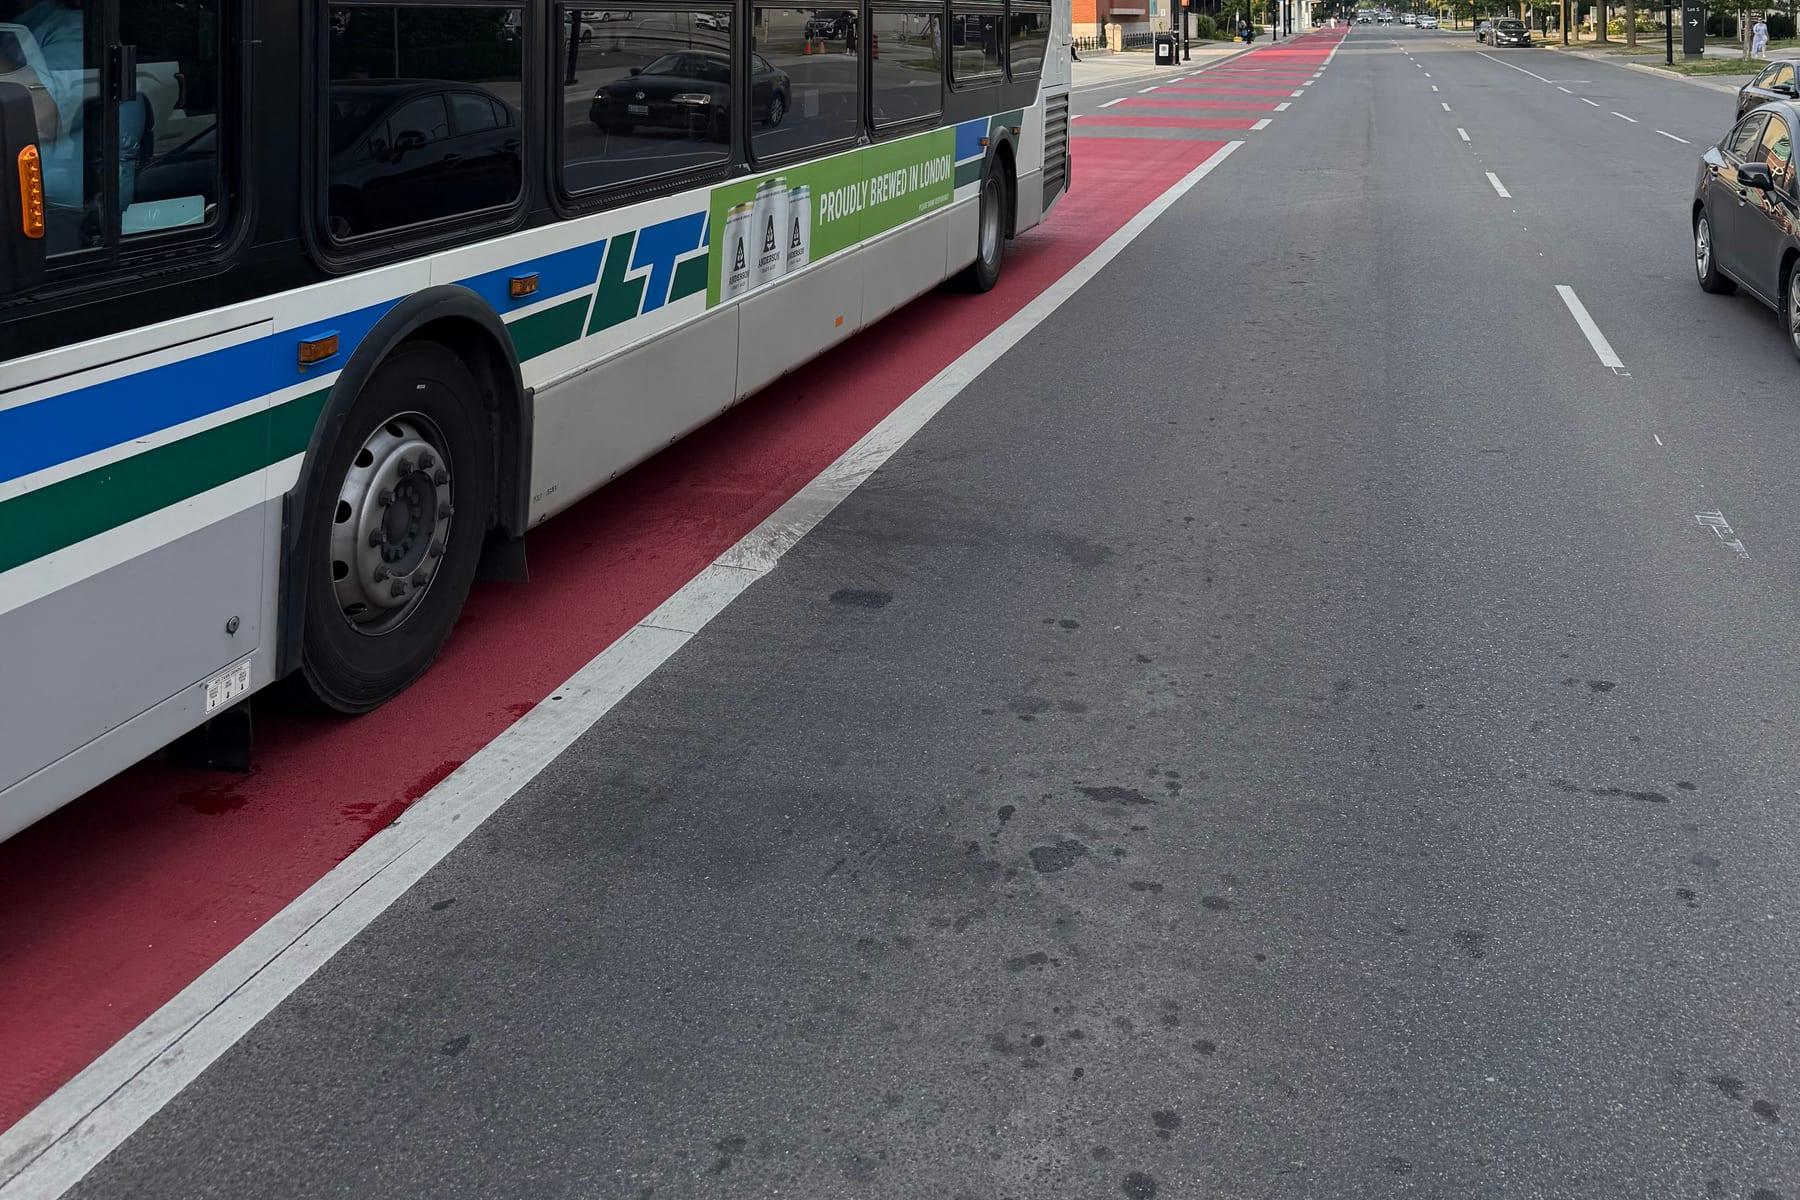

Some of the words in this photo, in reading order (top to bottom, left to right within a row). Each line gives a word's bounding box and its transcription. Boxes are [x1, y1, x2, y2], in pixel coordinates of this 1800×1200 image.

[819, 180, 869, 226] PROUDLY
[870, 168, 907, 207] BREWED
[909, 164, 918, 193] IN
[920, 154, 951, 188] LONDON
